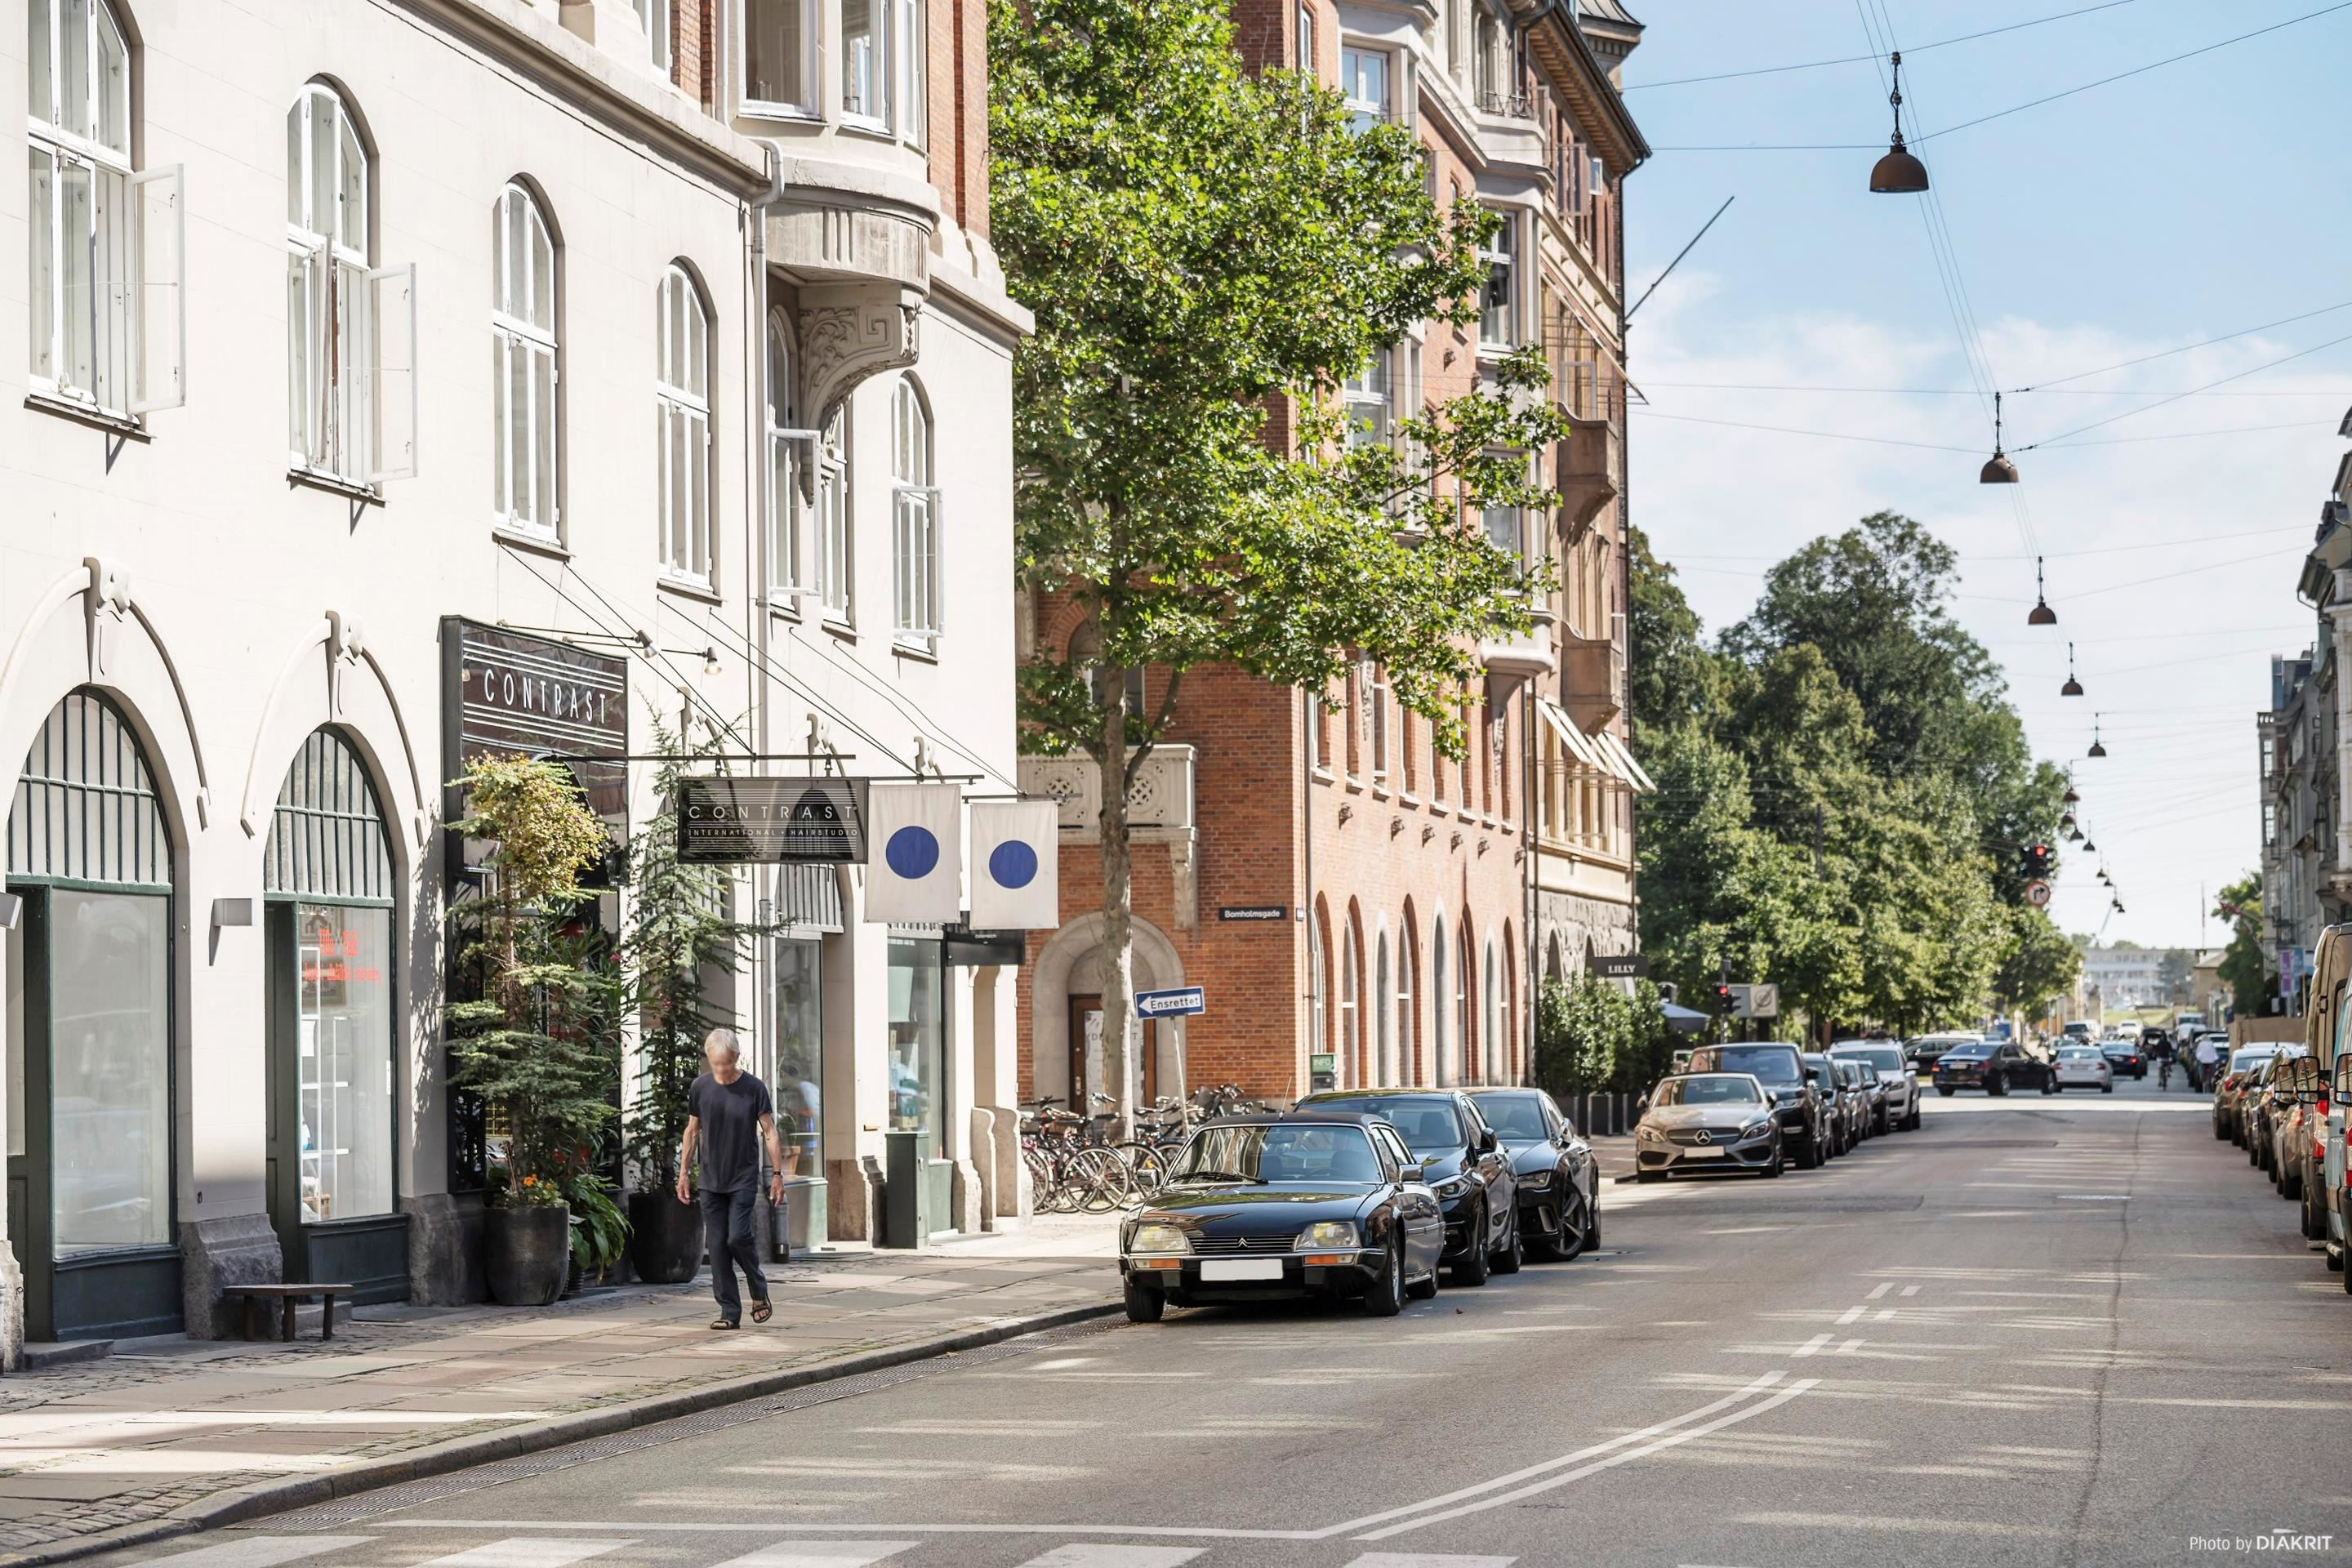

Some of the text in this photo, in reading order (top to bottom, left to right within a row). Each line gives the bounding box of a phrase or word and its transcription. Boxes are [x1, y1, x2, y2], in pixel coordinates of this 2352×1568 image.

[483, 668, 607, 724] CONTRAST
[688, 805, 853, 819] CONTRAST
[688, 828, 858, 836] INTERNATIONAL HAIRSTUDIO
[1224, 910, 1281, 919] Bornholmsgade
[1608, 964, 1636, 974] LILLY
[1150, 997, 1200, 1009] Ensrettet
